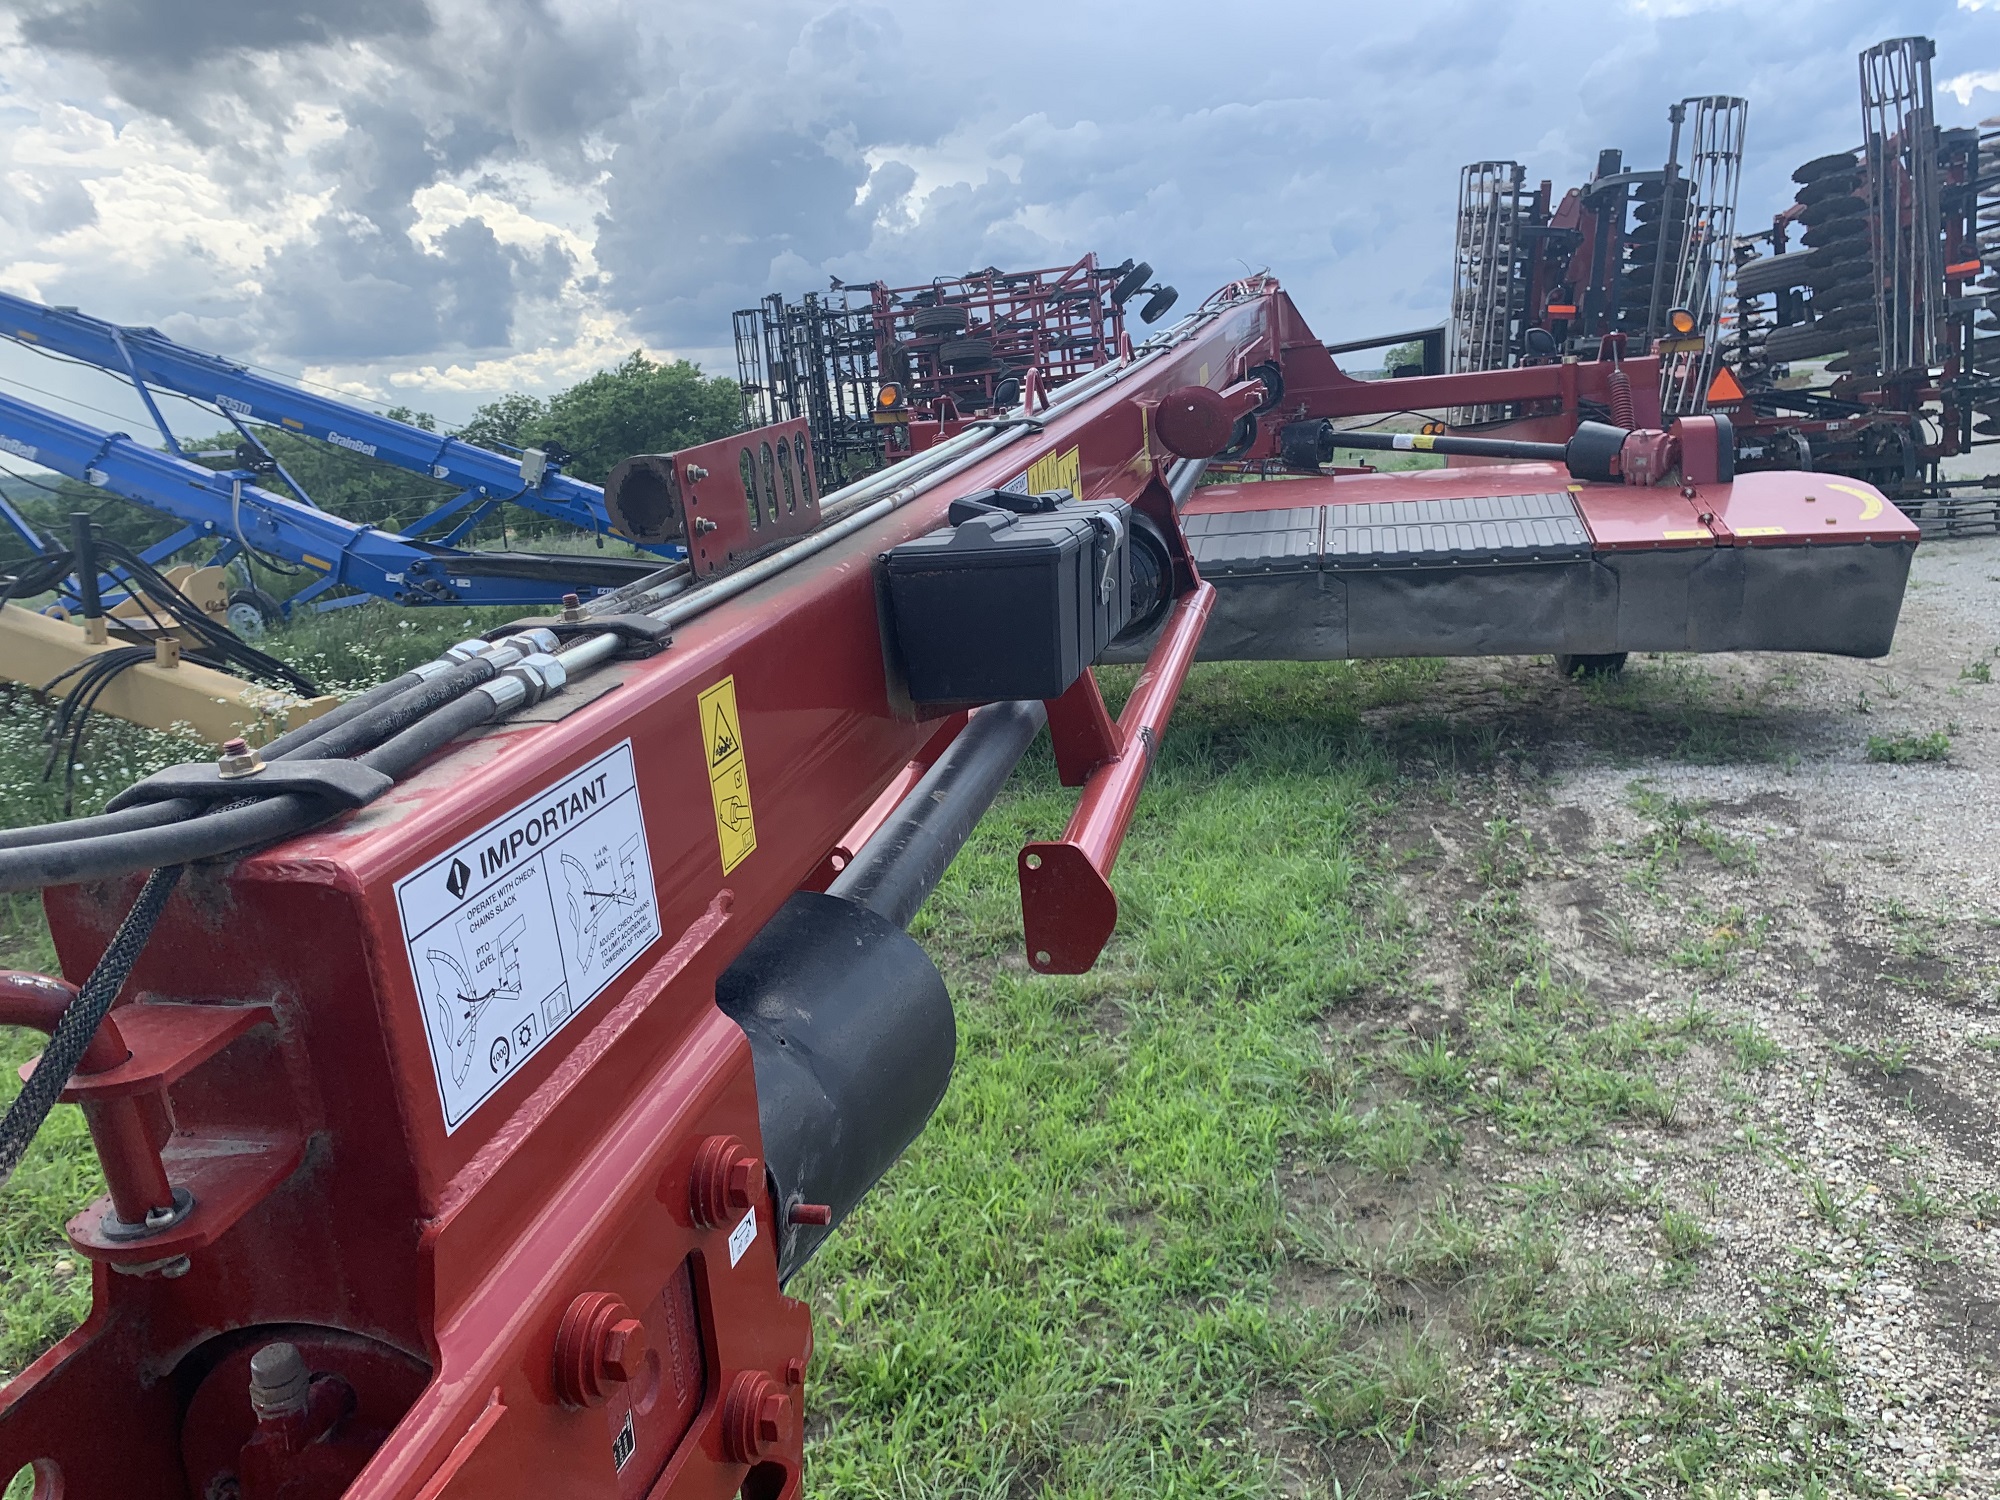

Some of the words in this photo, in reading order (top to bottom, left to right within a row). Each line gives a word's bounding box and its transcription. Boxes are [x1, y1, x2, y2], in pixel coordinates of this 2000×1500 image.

[327, 431, 377, 457] GrainBelt
[479, 772, 607, 879] IMPORTANT
[466, 893, 498, 920] OPERATE
[497, 880, 514, 901] WITH
[514, 866, 537, 886] CHECK
[469, 910, 495, 934] CHAINS
[495, 893, 518, 915] SLACK
[599, 928, 617, 949] ADJUST
[617, 915, 634, 932] CHECK
[634, 900, 650, 918] CHAINS
[600, 948, 608, 959] TO
[608, 938, 621, 953] LIMIT
[621, 914, 648, 941] ACCIDENTAL
[602, 942, 627, 970] LOWERING
[626, 937, 634, 947] OF
[634, 920, 652, 940] TONGUE
[475, 941, 490, 958] PTO
[475, 953, 497, 974] LEVEL
[492, 1045, 507, 1064] 1000
